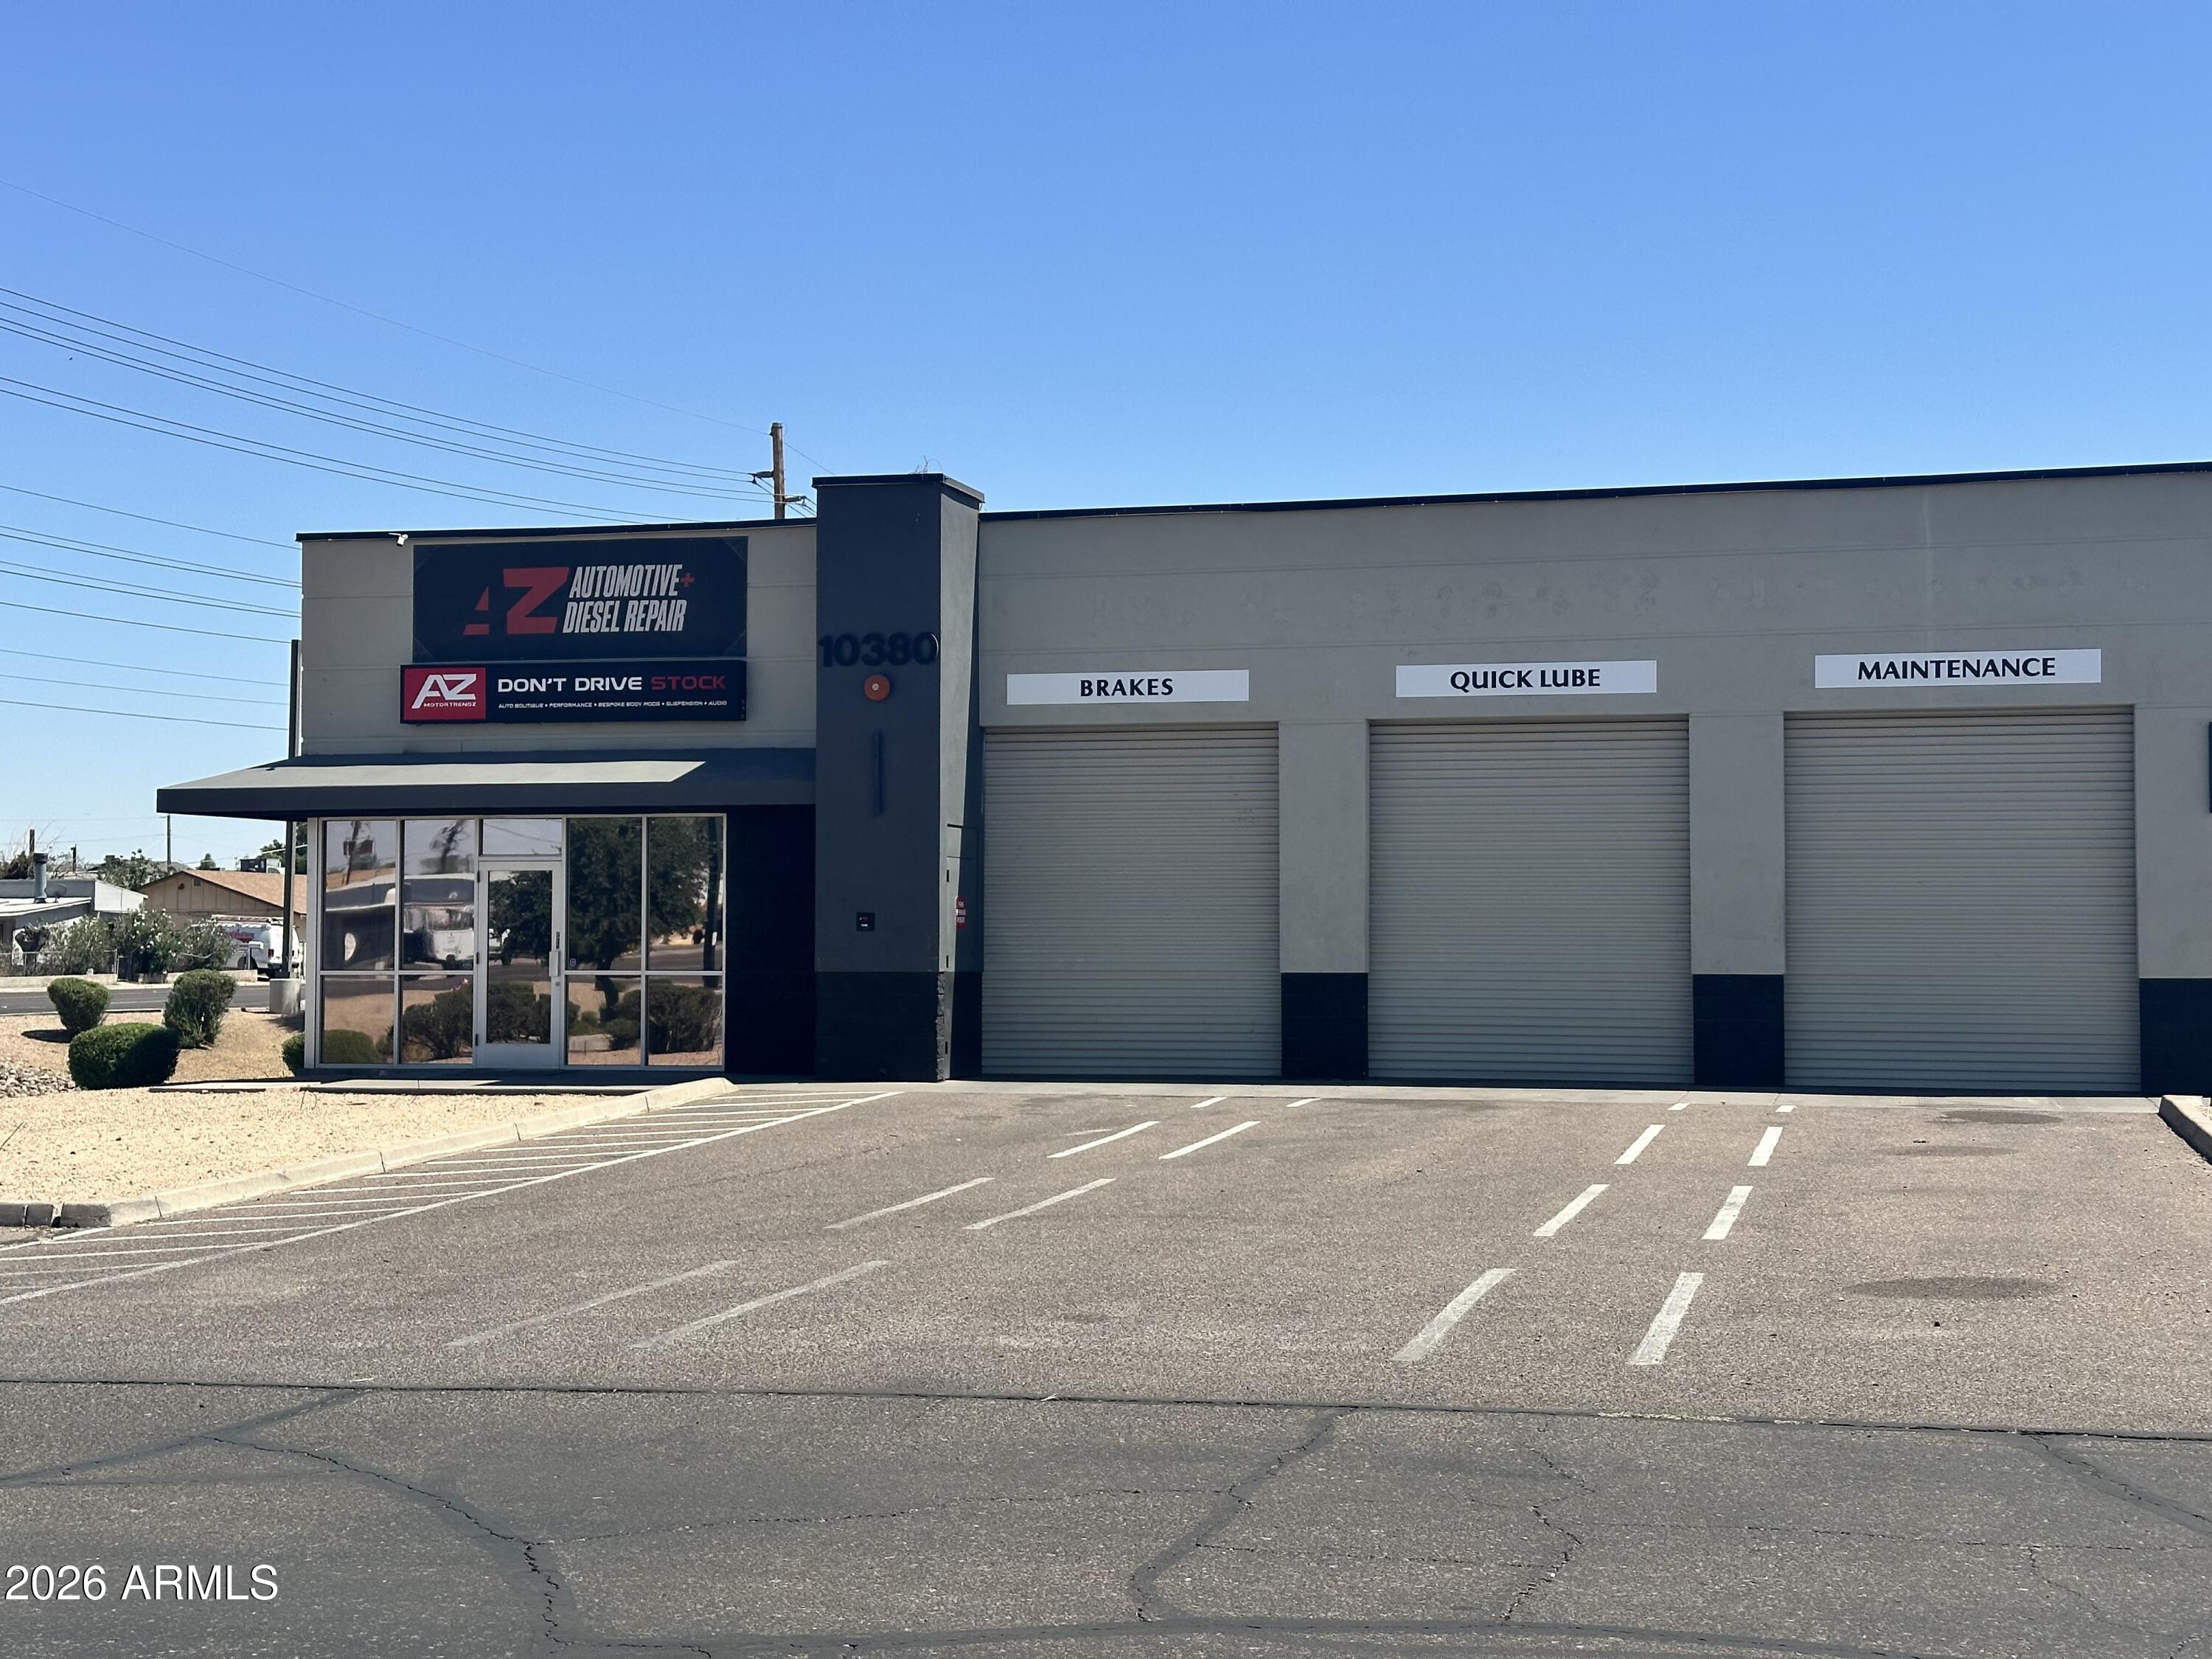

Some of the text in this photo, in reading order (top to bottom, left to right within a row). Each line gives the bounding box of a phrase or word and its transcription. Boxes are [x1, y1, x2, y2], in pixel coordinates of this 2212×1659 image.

[562, 599, 687, 633] DIESEL REPAIR
[818, 632, 939, 667] 10380
[1857, 657, 2056, 680] MAINTENANCE
[411, 673, 477, 709] AZ
[498, 675, 726, 692] DON'T DRIVE STOCK
[1080, 678, 1174, 697] BRAKES
[1450, 669, 1601, 693] QUICK LUBE
